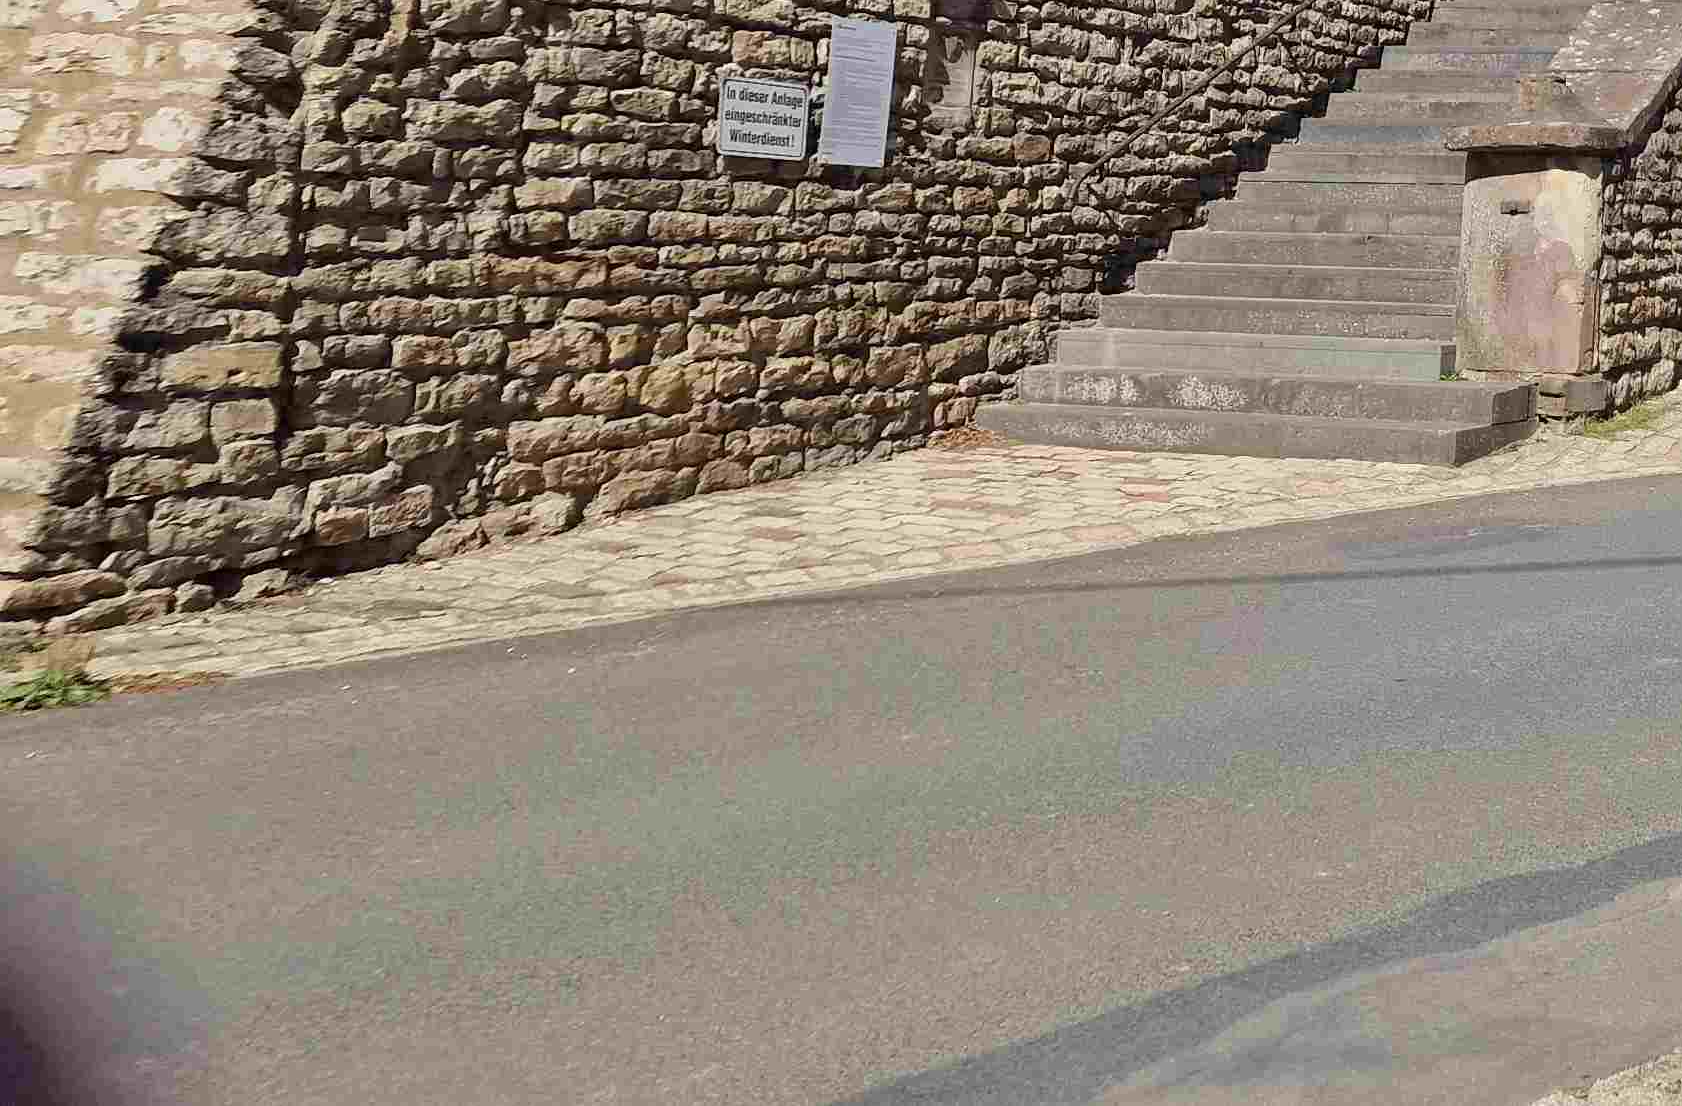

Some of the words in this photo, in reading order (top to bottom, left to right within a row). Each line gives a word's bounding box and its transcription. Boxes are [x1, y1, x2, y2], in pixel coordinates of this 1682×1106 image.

[727, 86, 736, 100] In
[739, 89, 769, 104] dieser
[771, 91, 803, 110] Anlage
[725, 109, 801, 128] eingeschränkter
[729, 128, 795, 148] Winterdienst!
